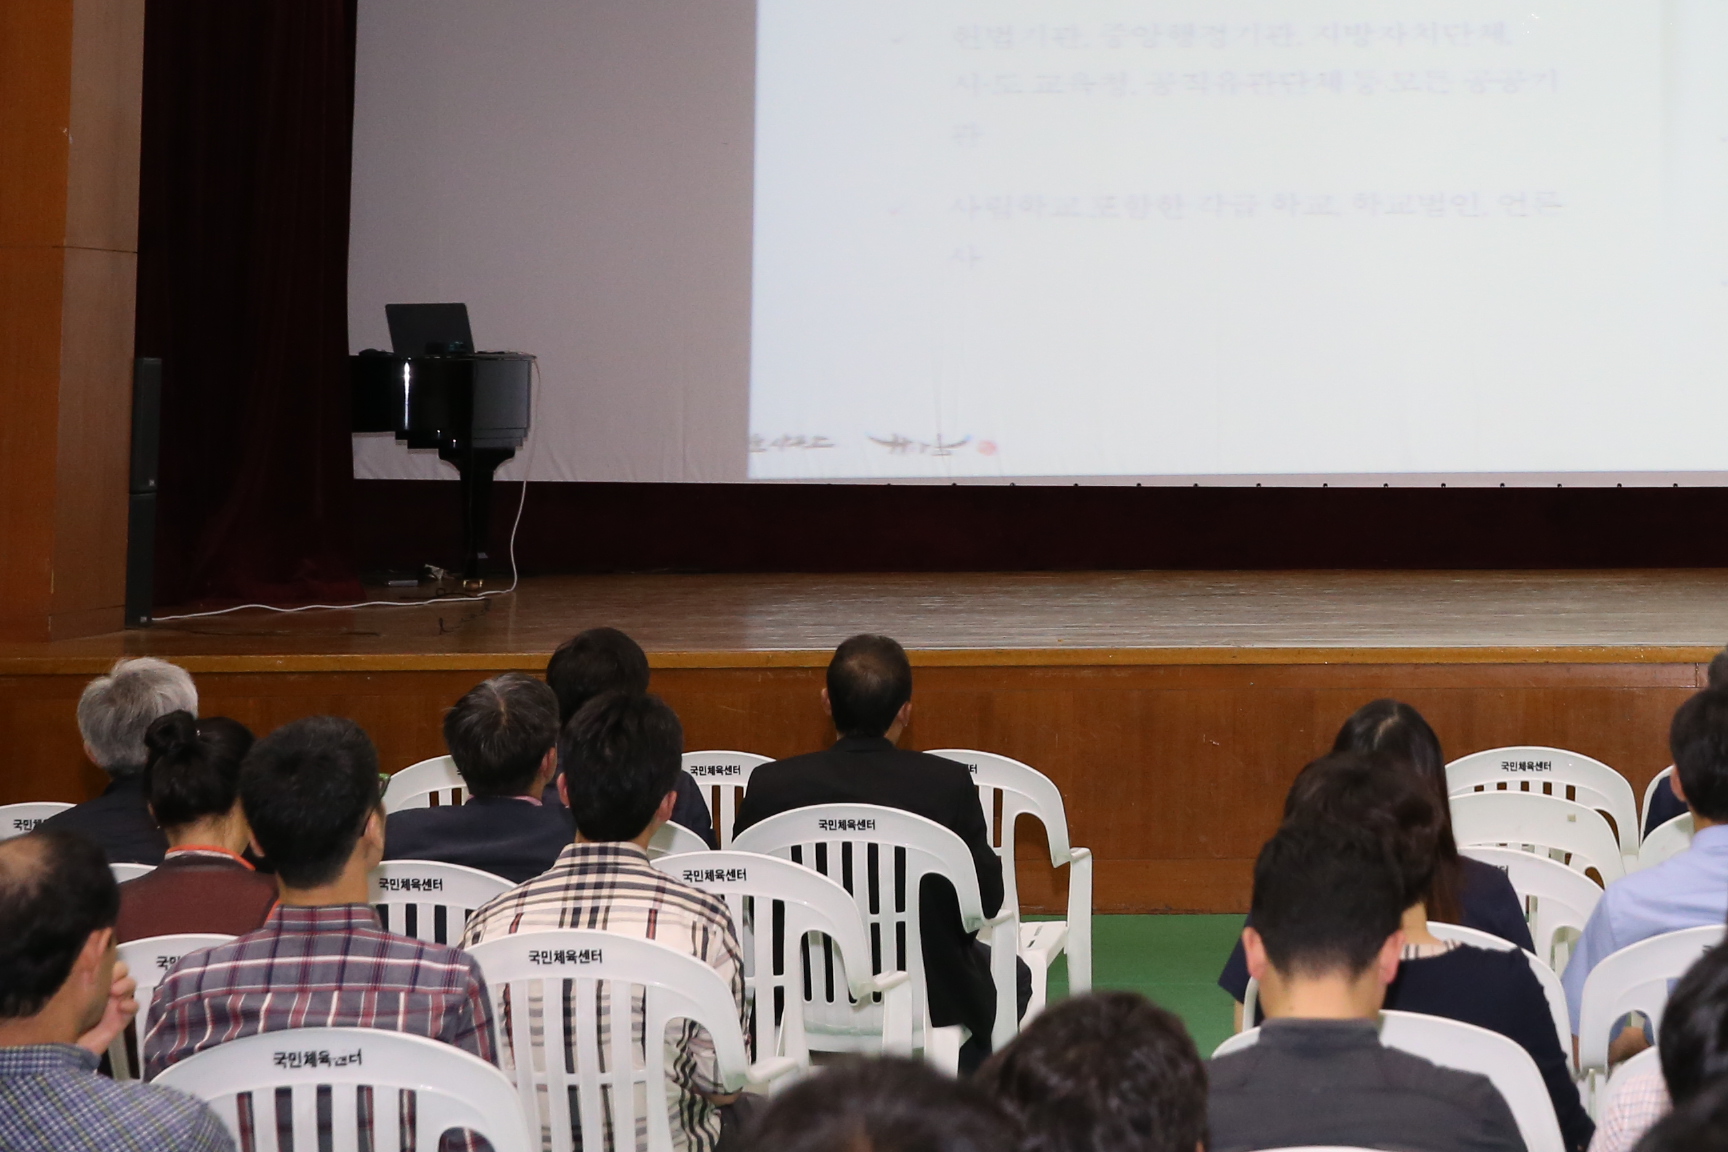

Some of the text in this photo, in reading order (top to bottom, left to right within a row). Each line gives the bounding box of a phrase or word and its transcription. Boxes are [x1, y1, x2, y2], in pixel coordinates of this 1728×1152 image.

[690, 765, 741, 777] 국민체육센터
[819, 818, 876, 831] 국민체육센터
[682, 868, 747, 883] 국민체육센터
[379, 877, 443, 892] 국민체육센터
[529, 949, 602, 965] 국민체육센터
